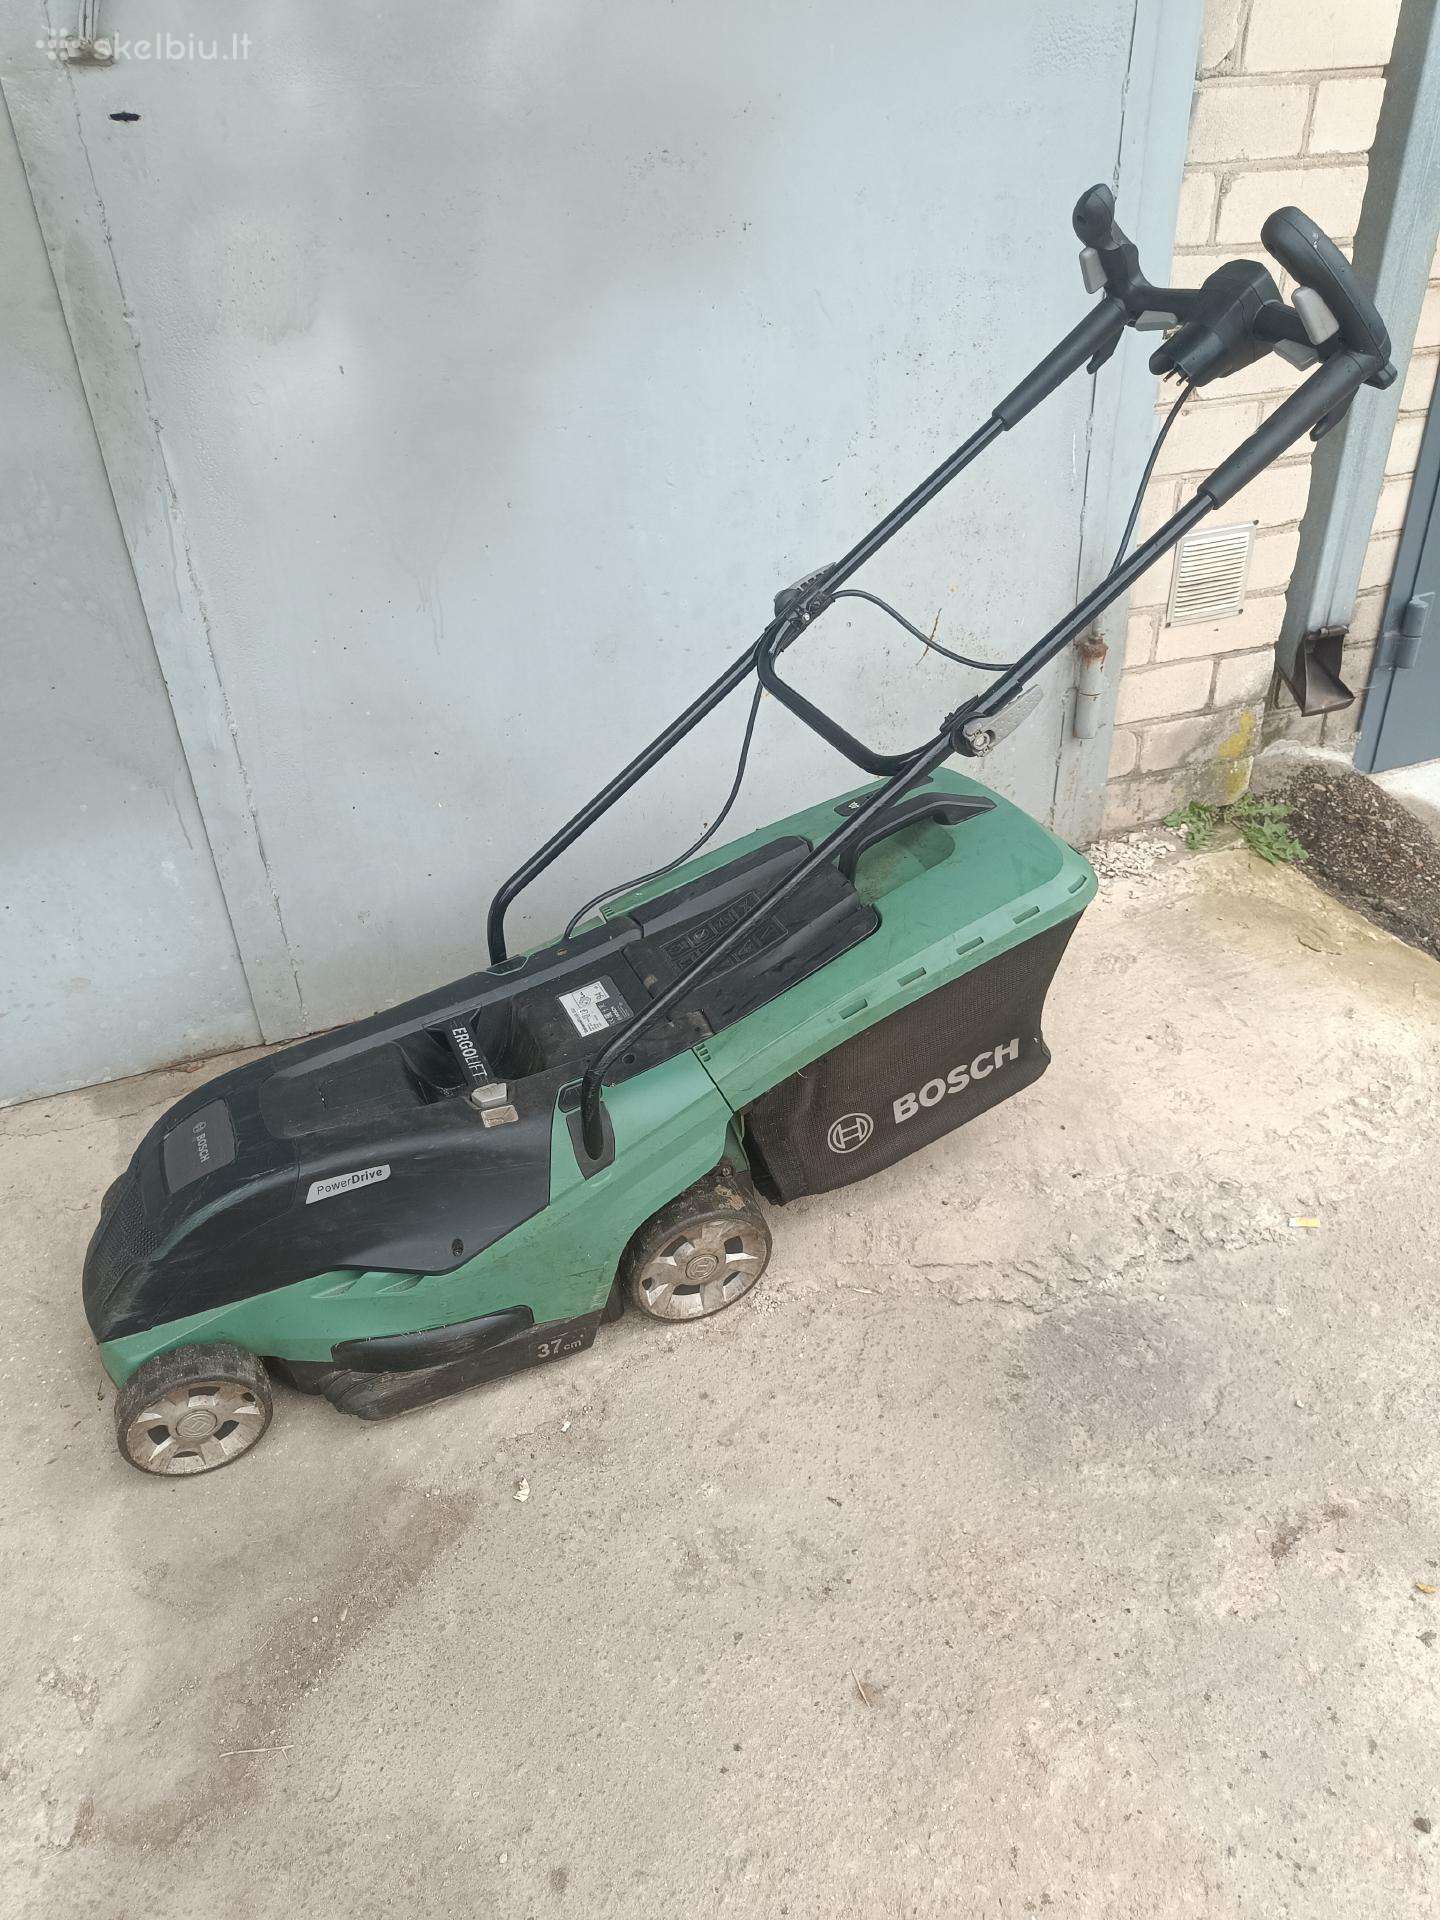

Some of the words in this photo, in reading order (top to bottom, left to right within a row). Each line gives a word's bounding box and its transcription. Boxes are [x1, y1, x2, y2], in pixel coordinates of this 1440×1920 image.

[452, 1027, 488, 1077] ERGOLIFT
[892, 1038, 1019, 1124] BOSCH
[196, 1132, 210, 1163] BOSCH
[316, 1169, 383, 1195] PowerDrive
